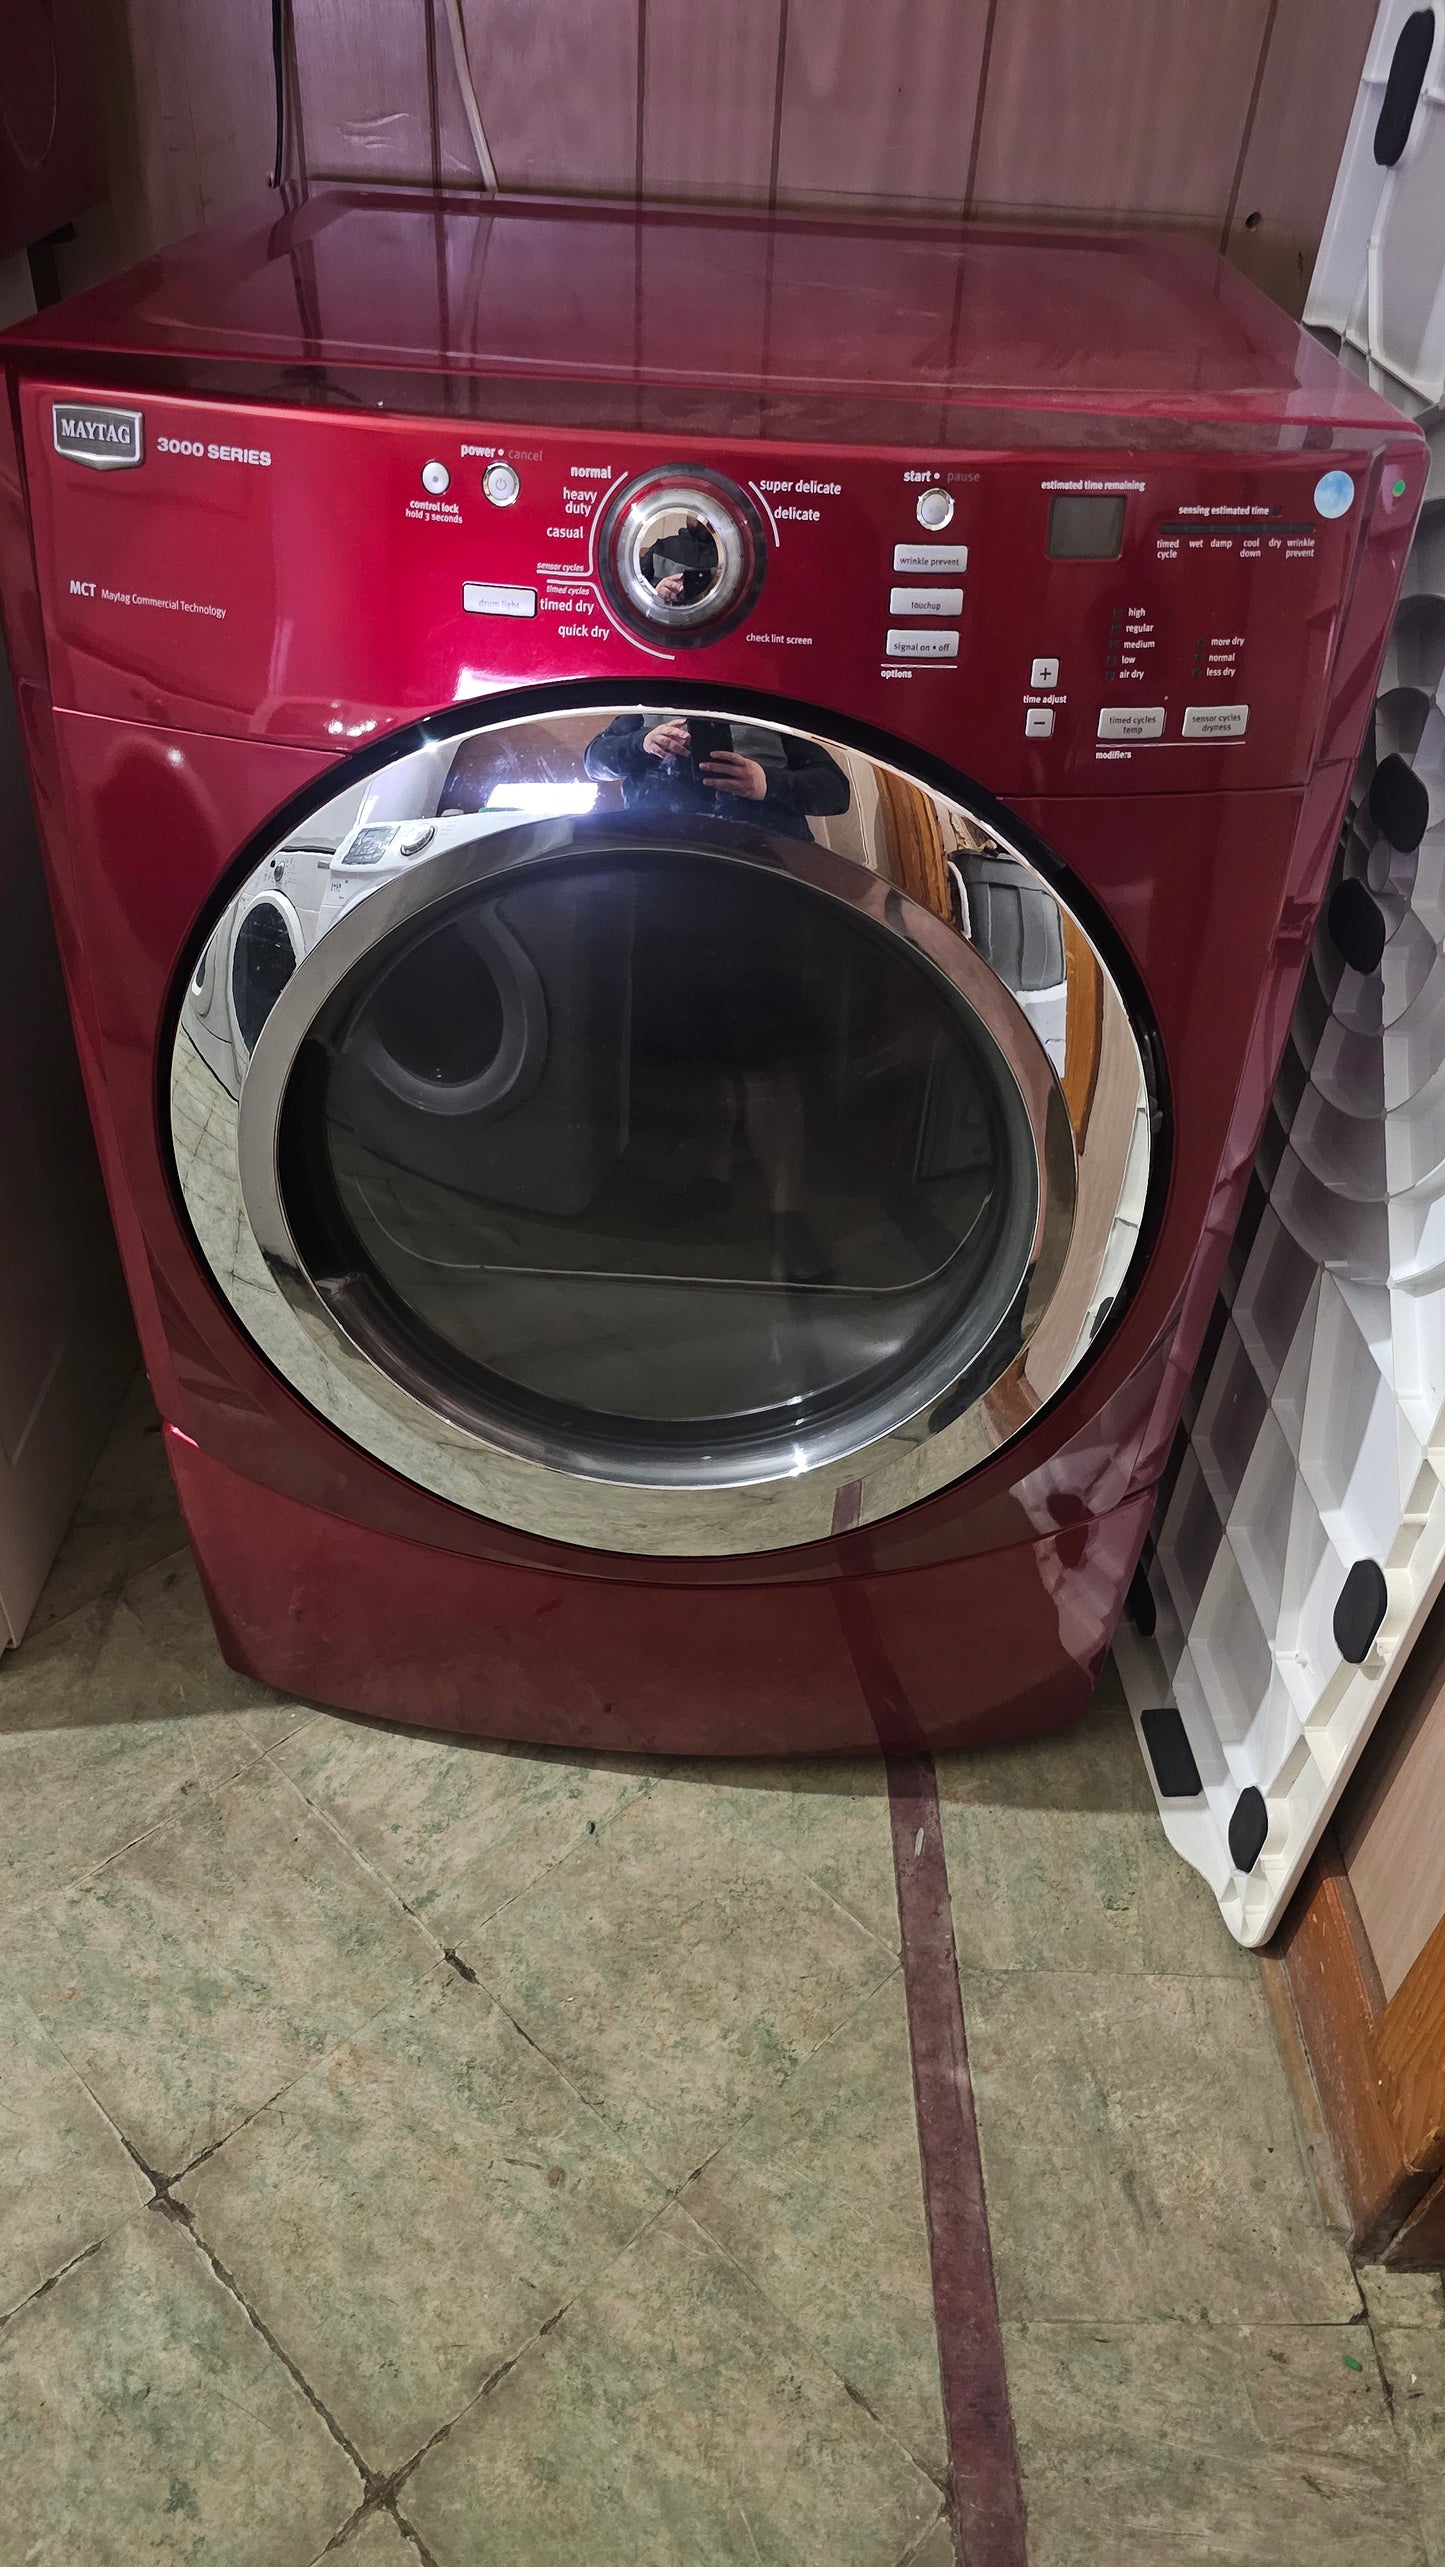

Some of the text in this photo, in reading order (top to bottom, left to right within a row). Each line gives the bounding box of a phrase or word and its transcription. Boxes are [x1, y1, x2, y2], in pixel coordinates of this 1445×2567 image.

[61, 418, 130, 445] MAYTAG
[157, 436, 271, 466] 3000 SERIES
[461, 444, 542, 462] power cancel
[571, 466, 611, 479] normal
[903, 471, 981, 483] start pause
[760, 478, 842, 495] super delicate
[1041, 480, 1145, 492] estimated time remaining
[563, 487, 597, 504] heavy
[410, 499, 459, 514] control lock
[565, 501, 591, 517] duty
[1178, 505, 1269, 517] sensing estimated time
[406, 509, 463, 524] hold 3 seconds
[774, 506, 821, 521] delicate
[546, 526, 583, 539] casual
[1157, 539, 1179, 549] timed
[1189, 539, 1203, 548] wet
[1210, 539, 1232, 550] damp
[1243, 538, 1260, 548] cool
[1268, 538, 1282, 550] dry
[1287, 537, 1315, 548] wrinkle
[1157, 549, 1177, 560] cycle
[1240, 548, 1261, 558] down
[1285, 548, 1314, 559] prevent
[537, 562, 584, 573] sensor cycles
[900, 556, 959, 568] wrinkle prevent
[546, 585, 589, 596] timed cycles
[69, 580, 226, 619] MCT Maytag Commercial Technology
[540, 598, 595, 615] timed dry
[911, 600, 941, 611] touchup
[1128, 607, 1146, 618] high
[558, 624, 610, 641] quick dry
[1126, 623, 1153, 634] regular
[746, 633, 813, 645] check lint screen
[1124, 639, 1155, 649] medium
[1211, 636, 1245, 648] more dry
[894, 642, 950, 653] signal on off
[1121, 655, 1135, 664] low
[1209, 653, 1235, 662] normal
[881, 669, 912, 680] options
[1119, 669, 1144, 680] air dry
[1206, 667, 1236, 678] less dry
[1023, 694, 1067, 705] time adjust
[1109, 715, 1156, 725] timed cycles
[1192, 713, 1241, 724] sensor cycles
[1123, 725, 1143, 735] temp
[1202, 723, 1231, 733] dryness
[1096, 750, 1131, 760] modifiers
